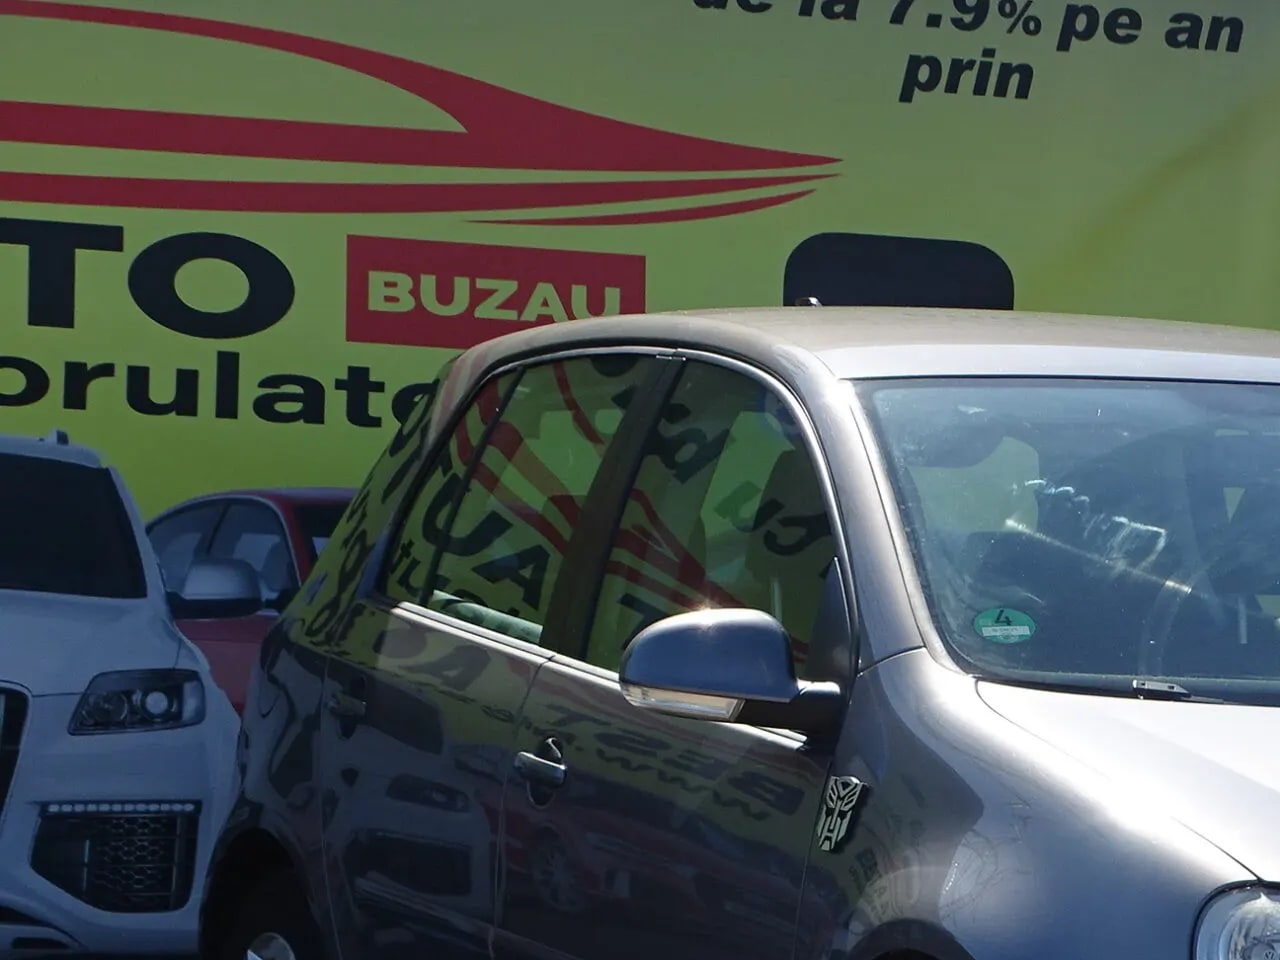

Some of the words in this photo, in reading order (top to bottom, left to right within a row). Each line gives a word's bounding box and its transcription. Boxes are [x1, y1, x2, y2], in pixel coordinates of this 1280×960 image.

[1056, 3, 1143, 52] pe
[1164, 11, 1246, 53] an
[899, 48, 1035, 103] prin
[368, 270, 621, 323] BUZAU
